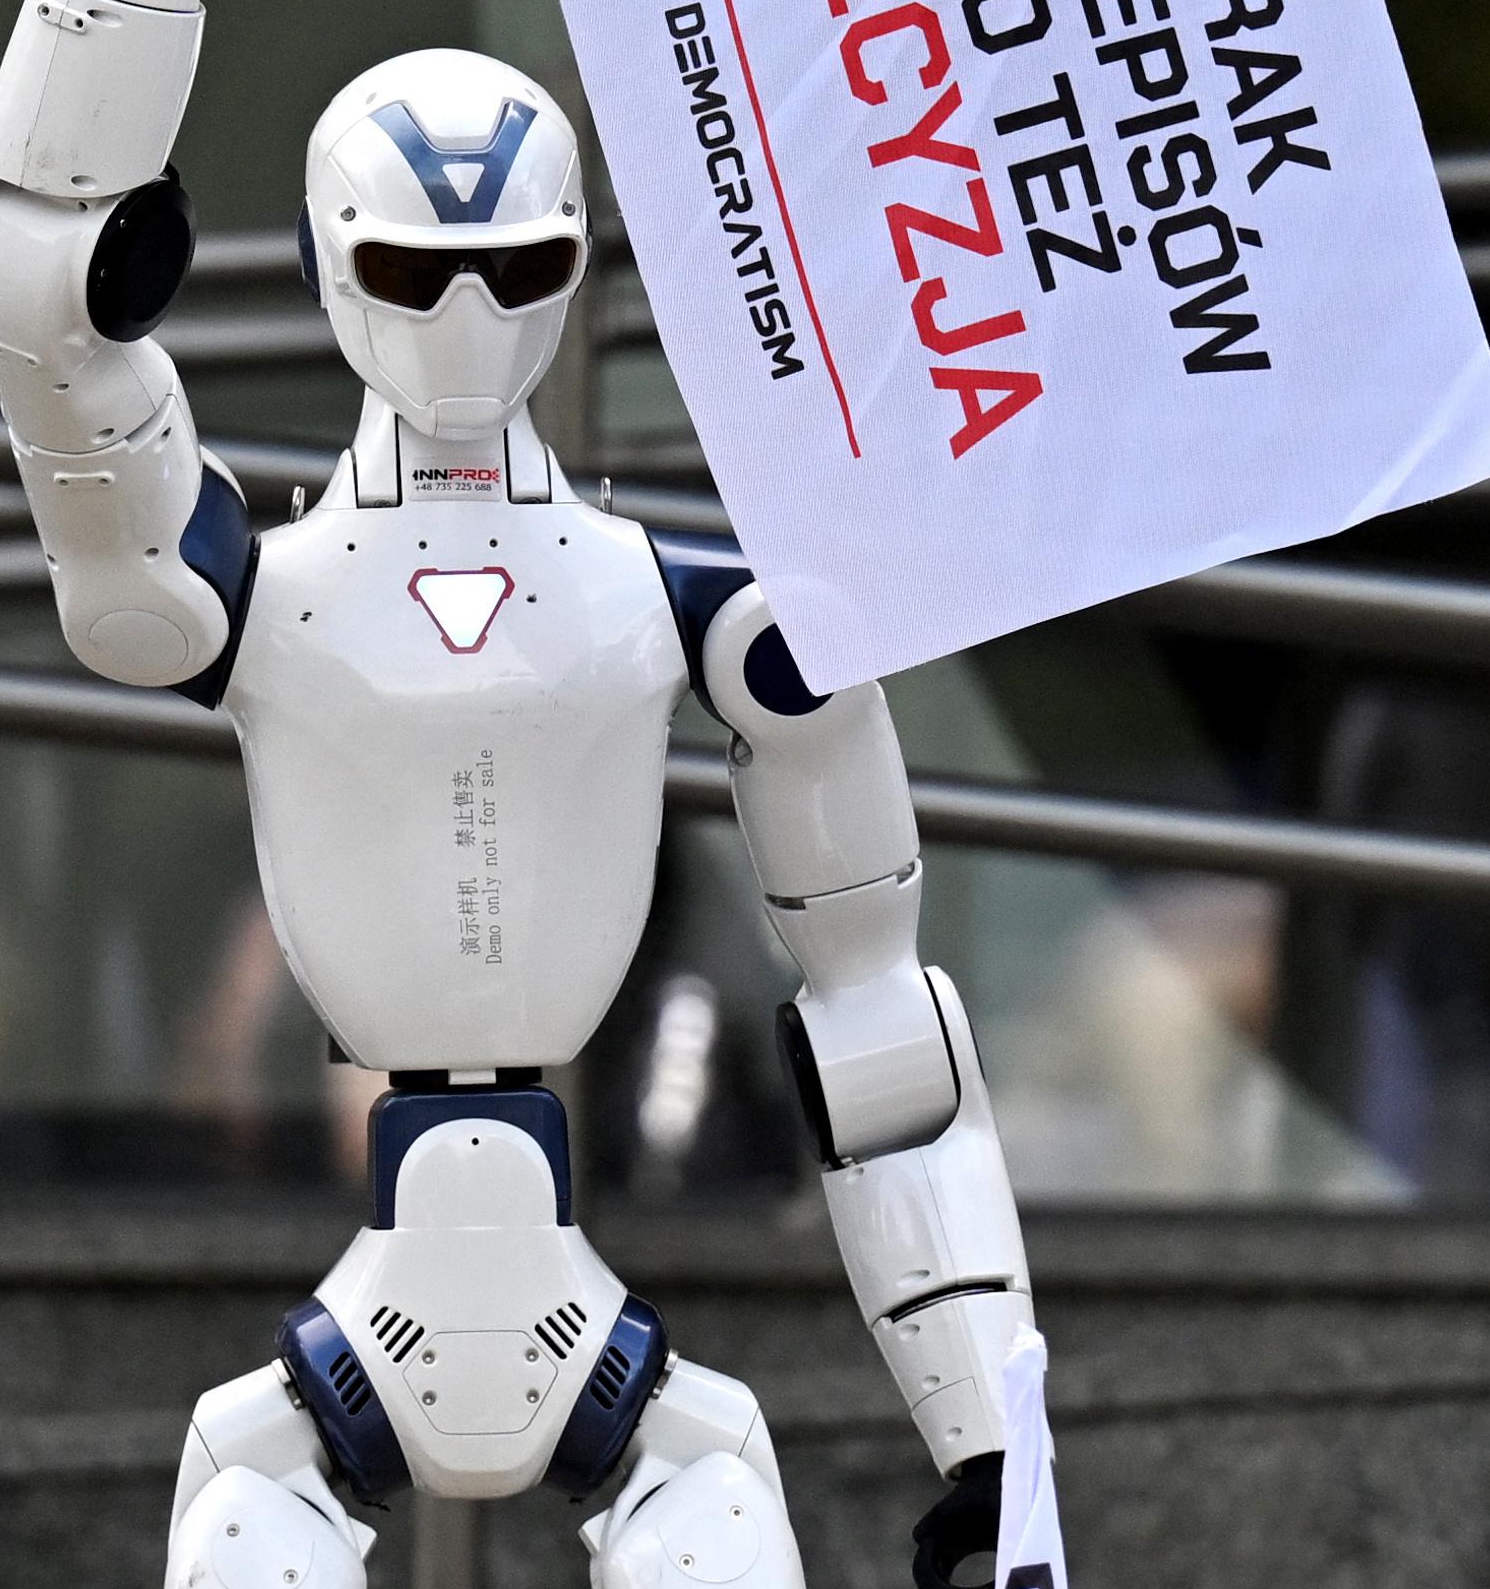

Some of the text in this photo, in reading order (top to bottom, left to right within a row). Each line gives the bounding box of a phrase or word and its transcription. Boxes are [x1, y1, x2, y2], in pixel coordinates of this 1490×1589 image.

[665, 3, 804, 380] DEMOCRATISM
[994, 72, 1136, 292] TEŻ
[412, 468, 493, 481] INNPRO
[415, 482, 492, 491] +48 735 225 688
[452, 769, 482, 955] 演示样机 禁止售卖
[476, 749, 502, 964] Demo only not for sale
